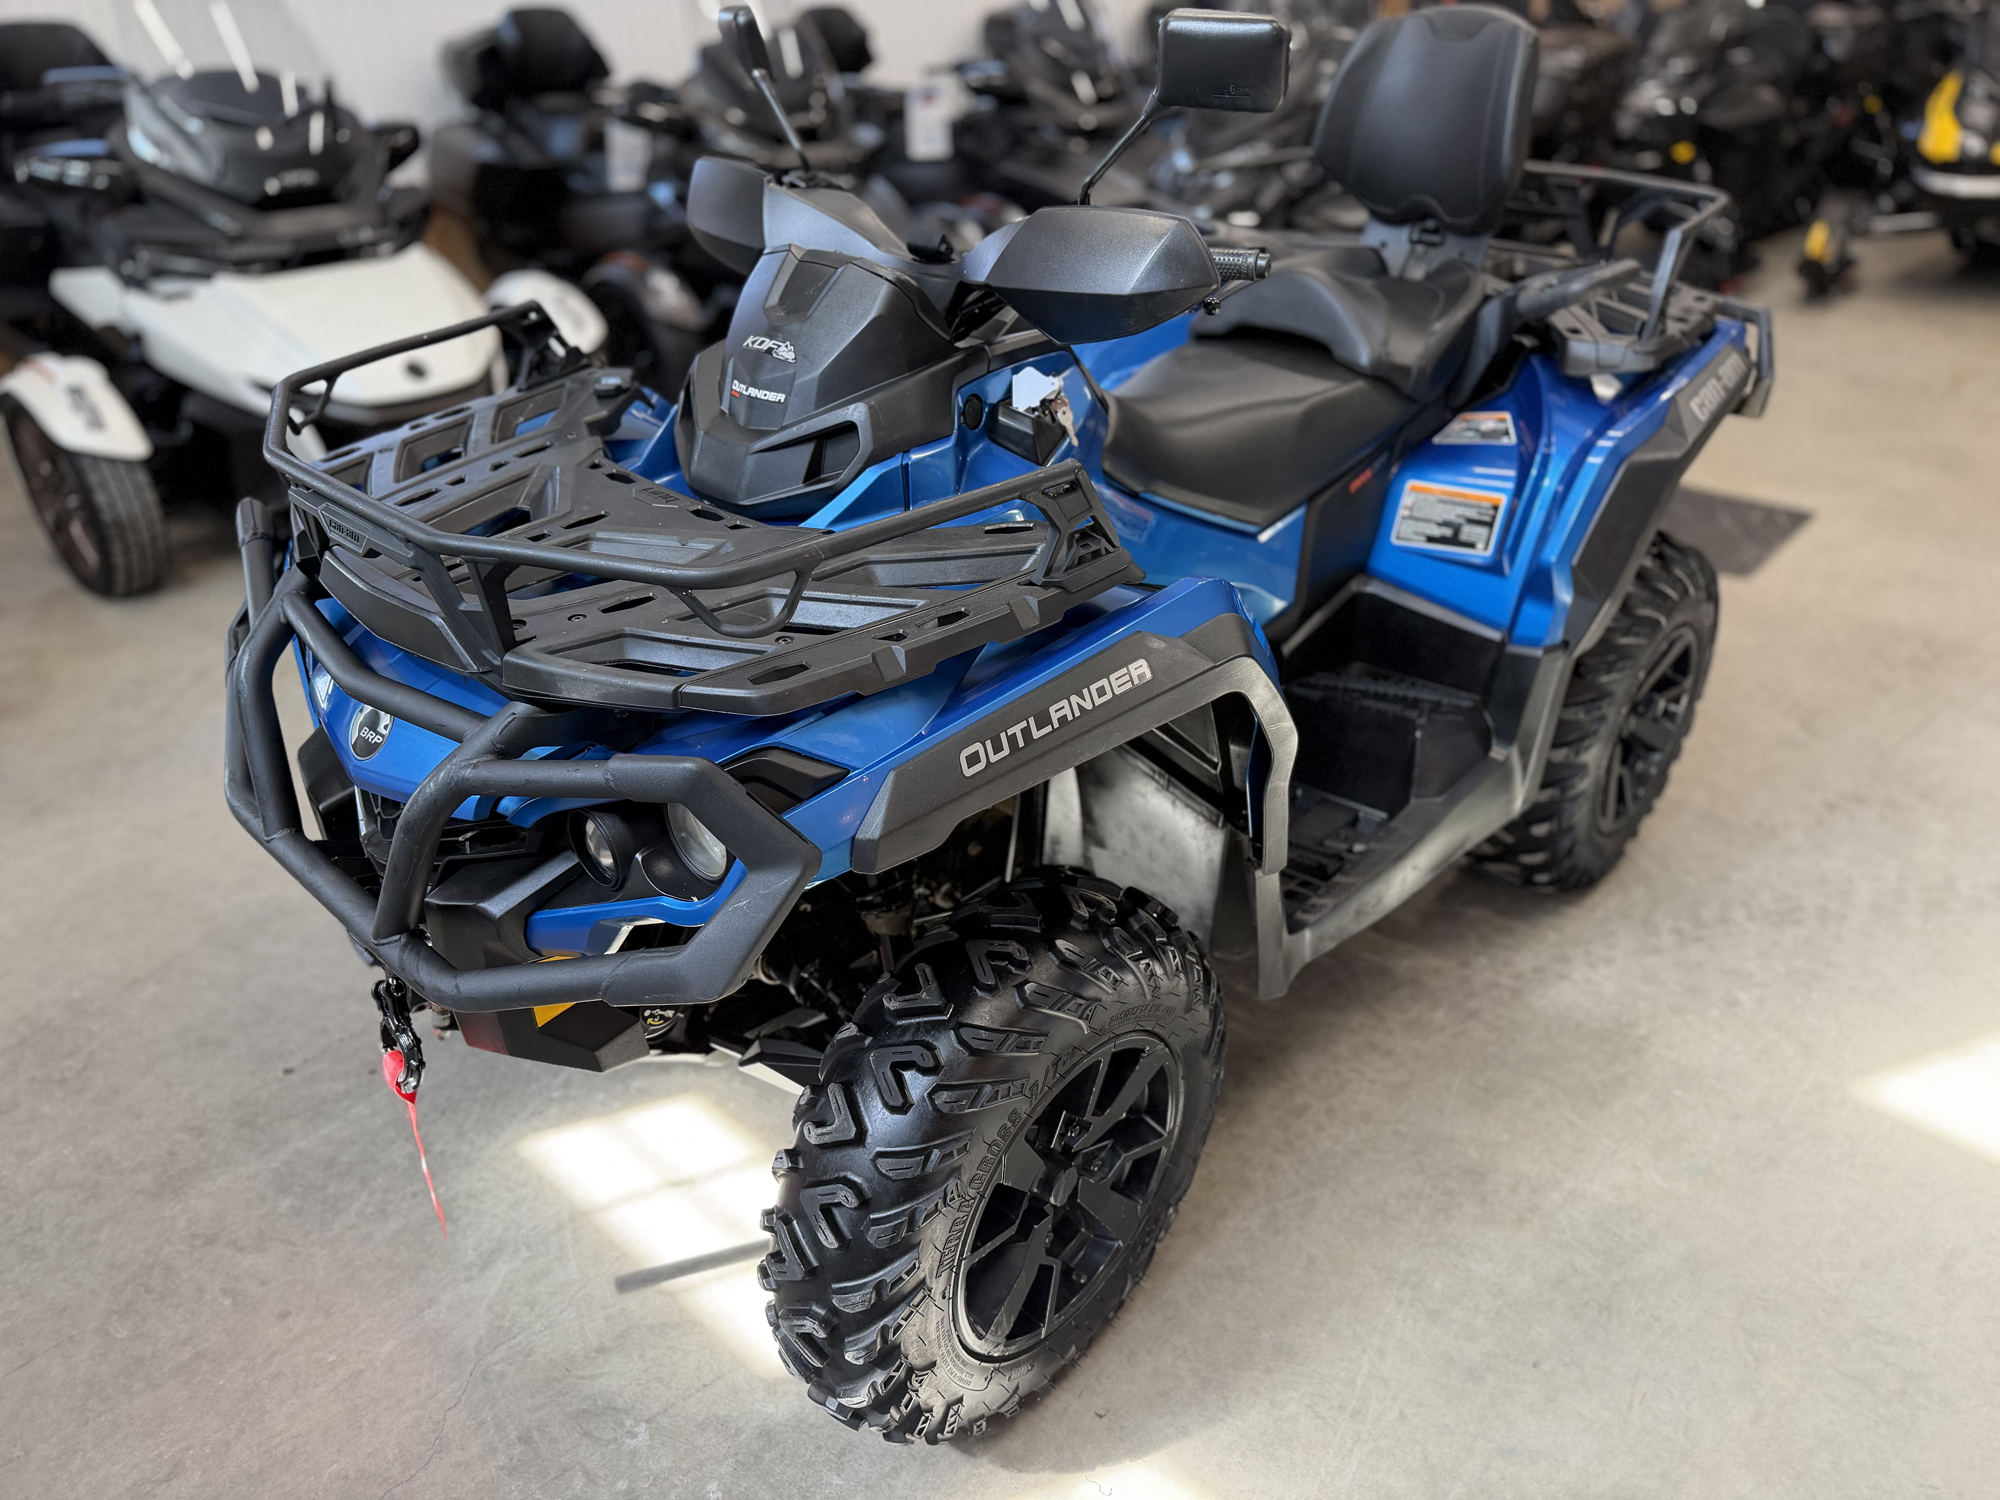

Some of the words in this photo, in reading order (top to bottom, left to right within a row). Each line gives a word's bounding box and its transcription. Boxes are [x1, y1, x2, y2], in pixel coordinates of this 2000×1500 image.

[742, 335, 785, 351] KDF
[731, 379, 786, 403] OUTLANDER
[960, 658, 1154, 778] OUTLANDER
[360, 726, 383, 744] BRP
[968, 1106, 1023, 1192] CROSS
